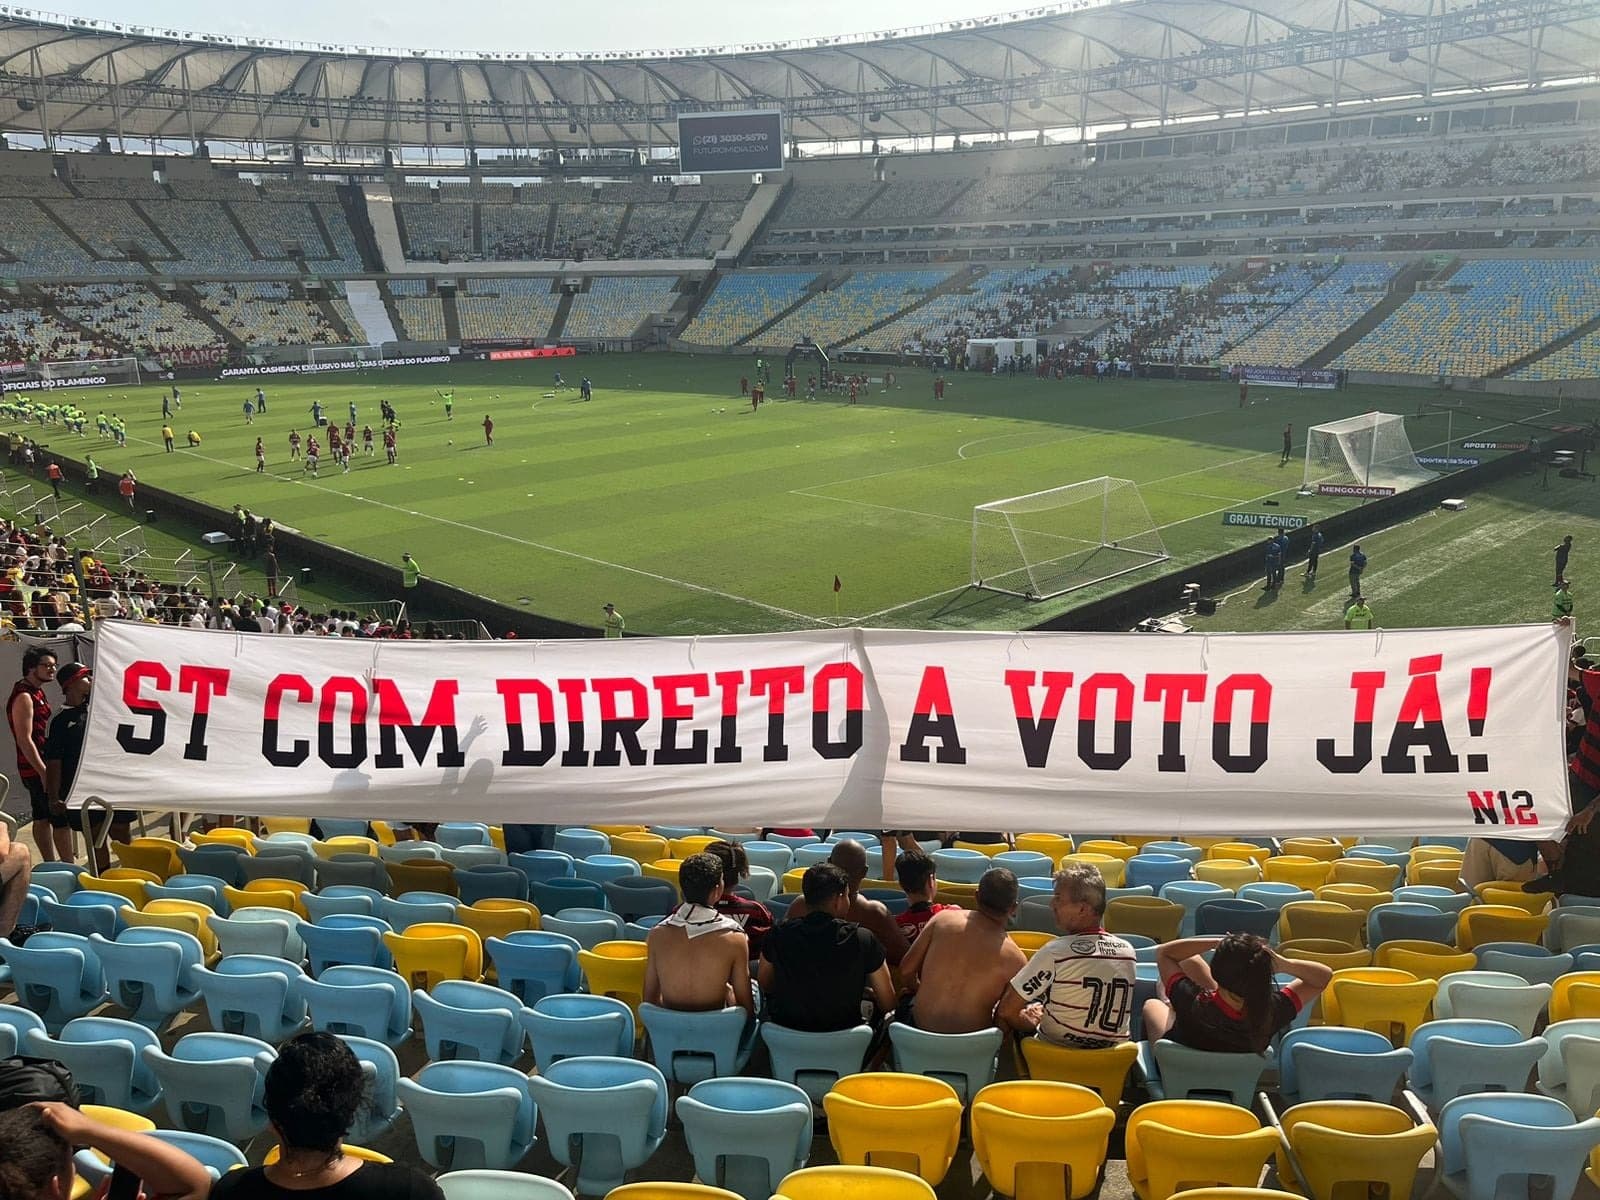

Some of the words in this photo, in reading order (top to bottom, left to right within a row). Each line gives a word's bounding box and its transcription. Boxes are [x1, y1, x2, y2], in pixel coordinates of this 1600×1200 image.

[222, 367, 259, 376] GARANTA
[260, 365, 301, 374] CASHBACK
[302, 362, 340, 371] EXCLUSIVO
[341, 361, 355, 369] NAS
[416, 355, 451, 364] FLAMENGO
[3, 381, 40, 390] OFICIAIS
[57, 377, 106, 386] FLAMENGO
[1458, 457, 1479, 465] Sorte
[1229, 513, 1257, 525] GRAU
[1258, 513, 1303, 528] TÉCNICO
[115, 660, 230, 761] ST
[261, 673, 465, 769] COM
[496, 662, 864, 767] DIREITO
[900, 666, 967, 765] A
[1004, 669, 1272, 773] VOTO
[1316, 653, 1492, 774] JÁ!
[1467, 790, 1539, 825] N12
